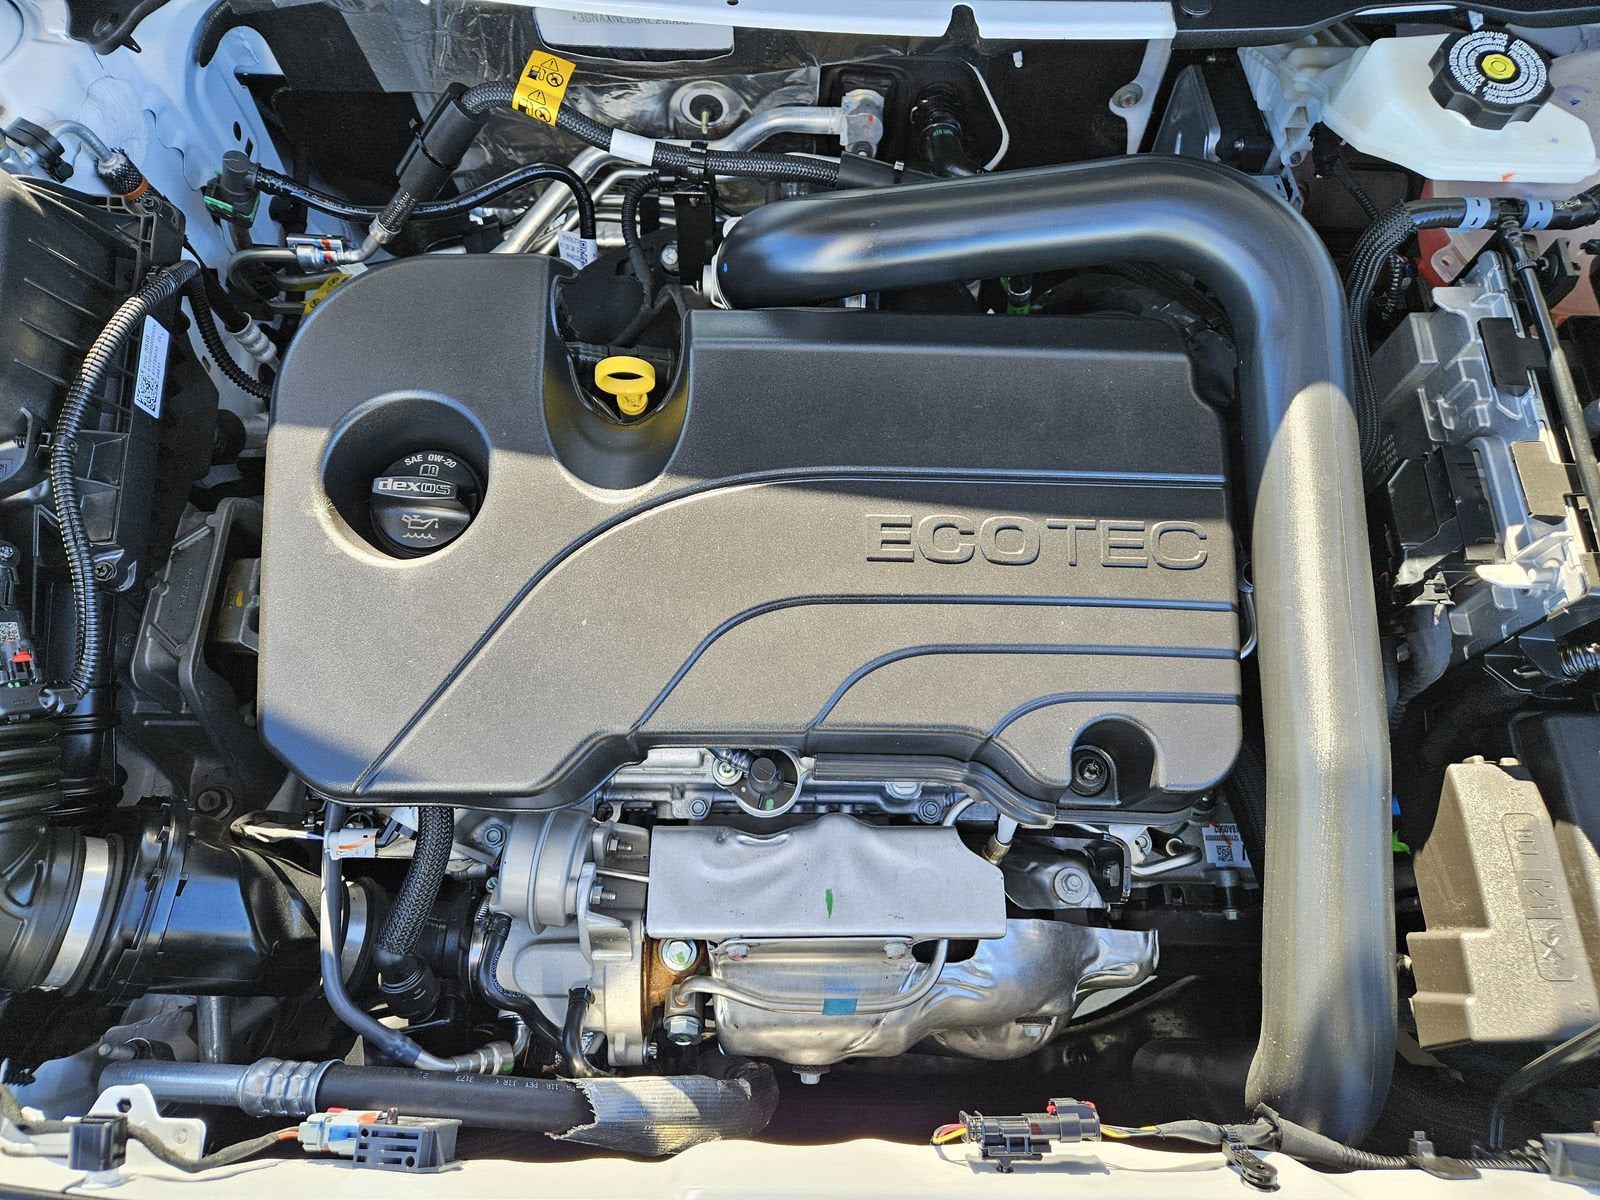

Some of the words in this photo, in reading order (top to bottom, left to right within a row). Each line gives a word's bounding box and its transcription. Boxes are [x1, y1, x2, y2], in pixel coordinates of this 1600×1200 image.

[405, 454, 423, 466] SAE
[378, 478, 451, 495] dexos
[865, 514, 1208, 570] ECOTEC
